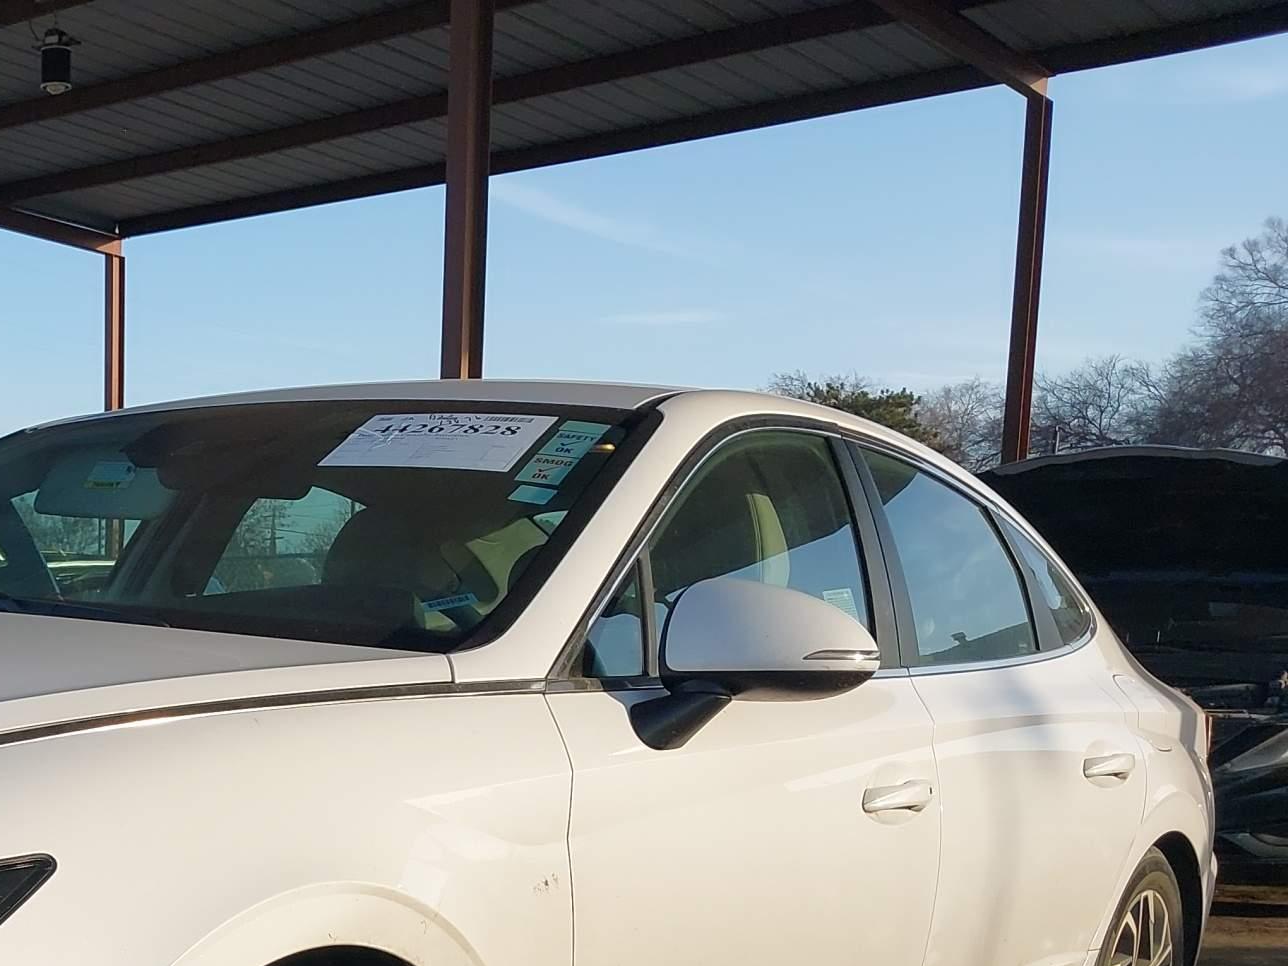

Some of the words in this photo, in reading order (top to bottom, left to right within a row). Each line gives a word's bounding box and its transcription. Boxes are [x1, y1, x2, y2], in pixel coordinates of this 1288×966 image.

[374, 423, 522, 437] 44267828
[556, 432, 598, 442] SAFETY
[555, 446, 574, 454] OK
[534, 457, 573, 467] SMOG
[532, 472, 551, 480] OK
